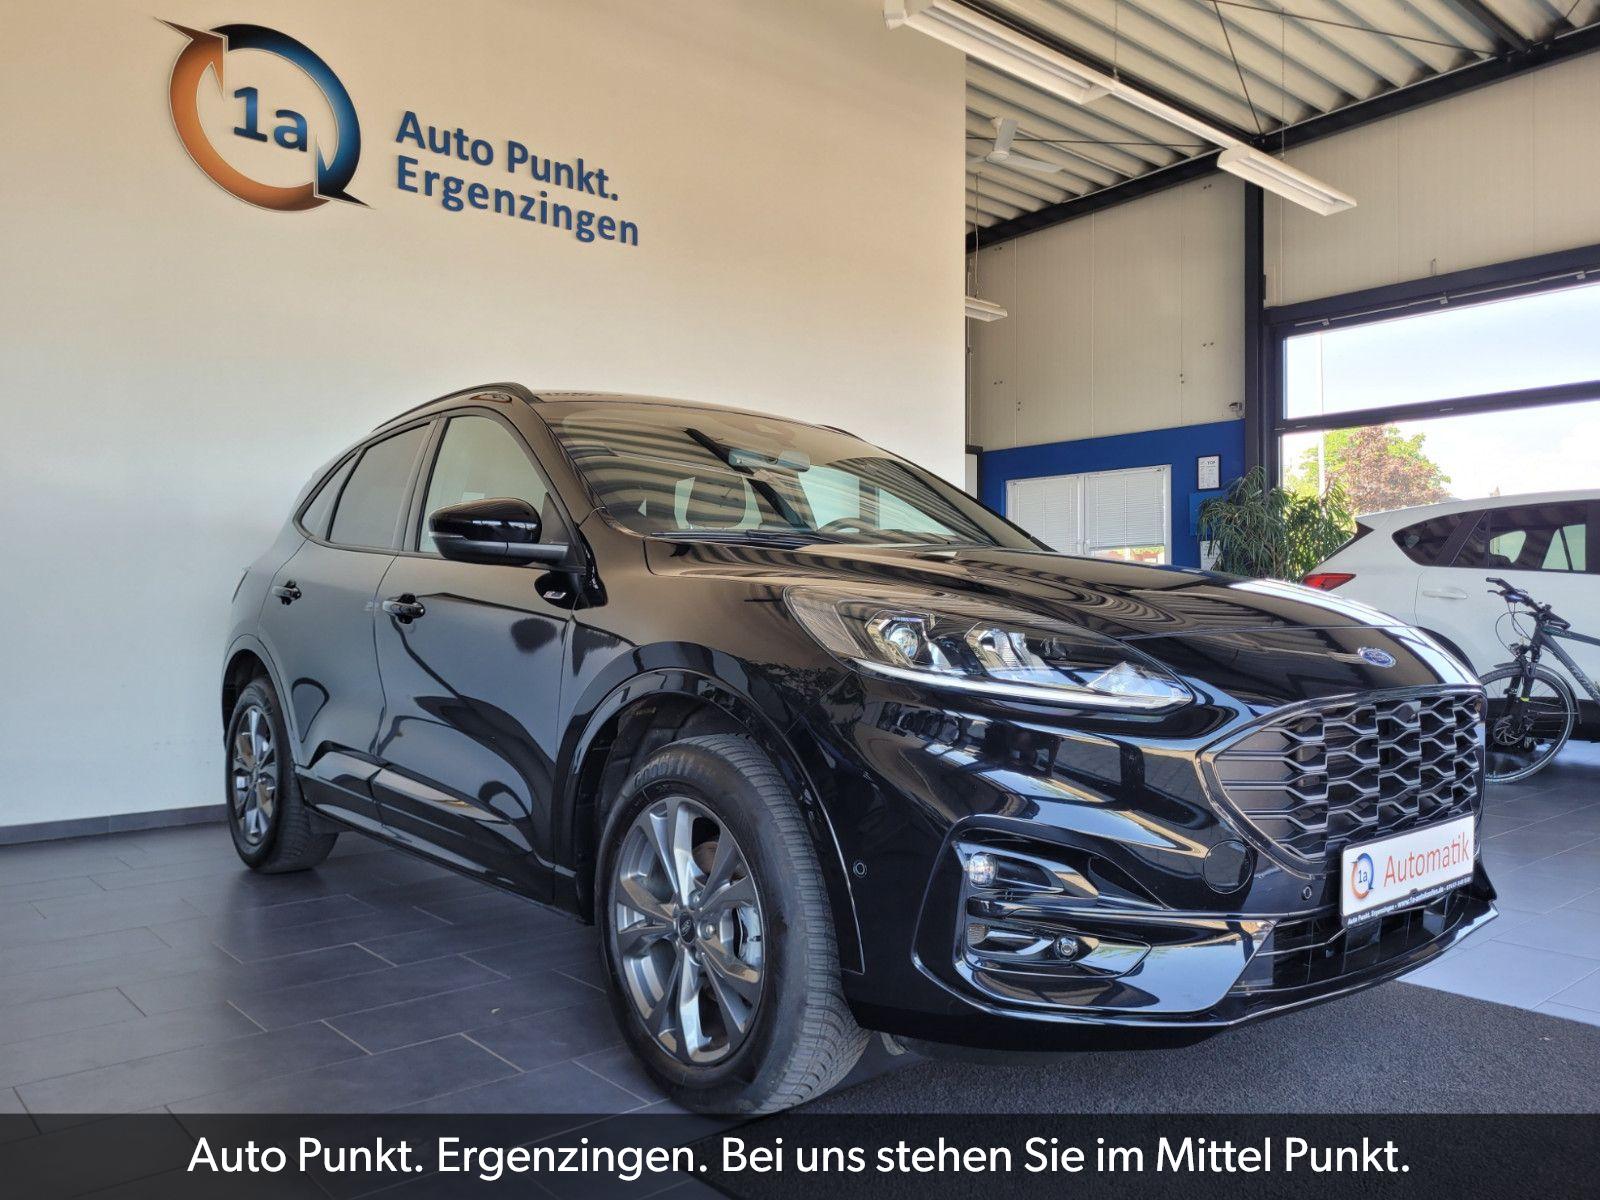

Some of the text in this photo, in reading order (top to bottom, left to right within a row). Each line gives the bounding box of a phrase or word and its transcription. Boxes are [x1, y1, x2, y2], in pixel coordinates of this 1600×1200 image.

[233, 87, 308, 152] 1a
[396, 110, 619, 202] Auto Punkt.
[396, 155, 639, 246] Ergenzingen
[1358, 869, 1368, 884] 1a
[1383, 831, 1470, 888] Automatik
